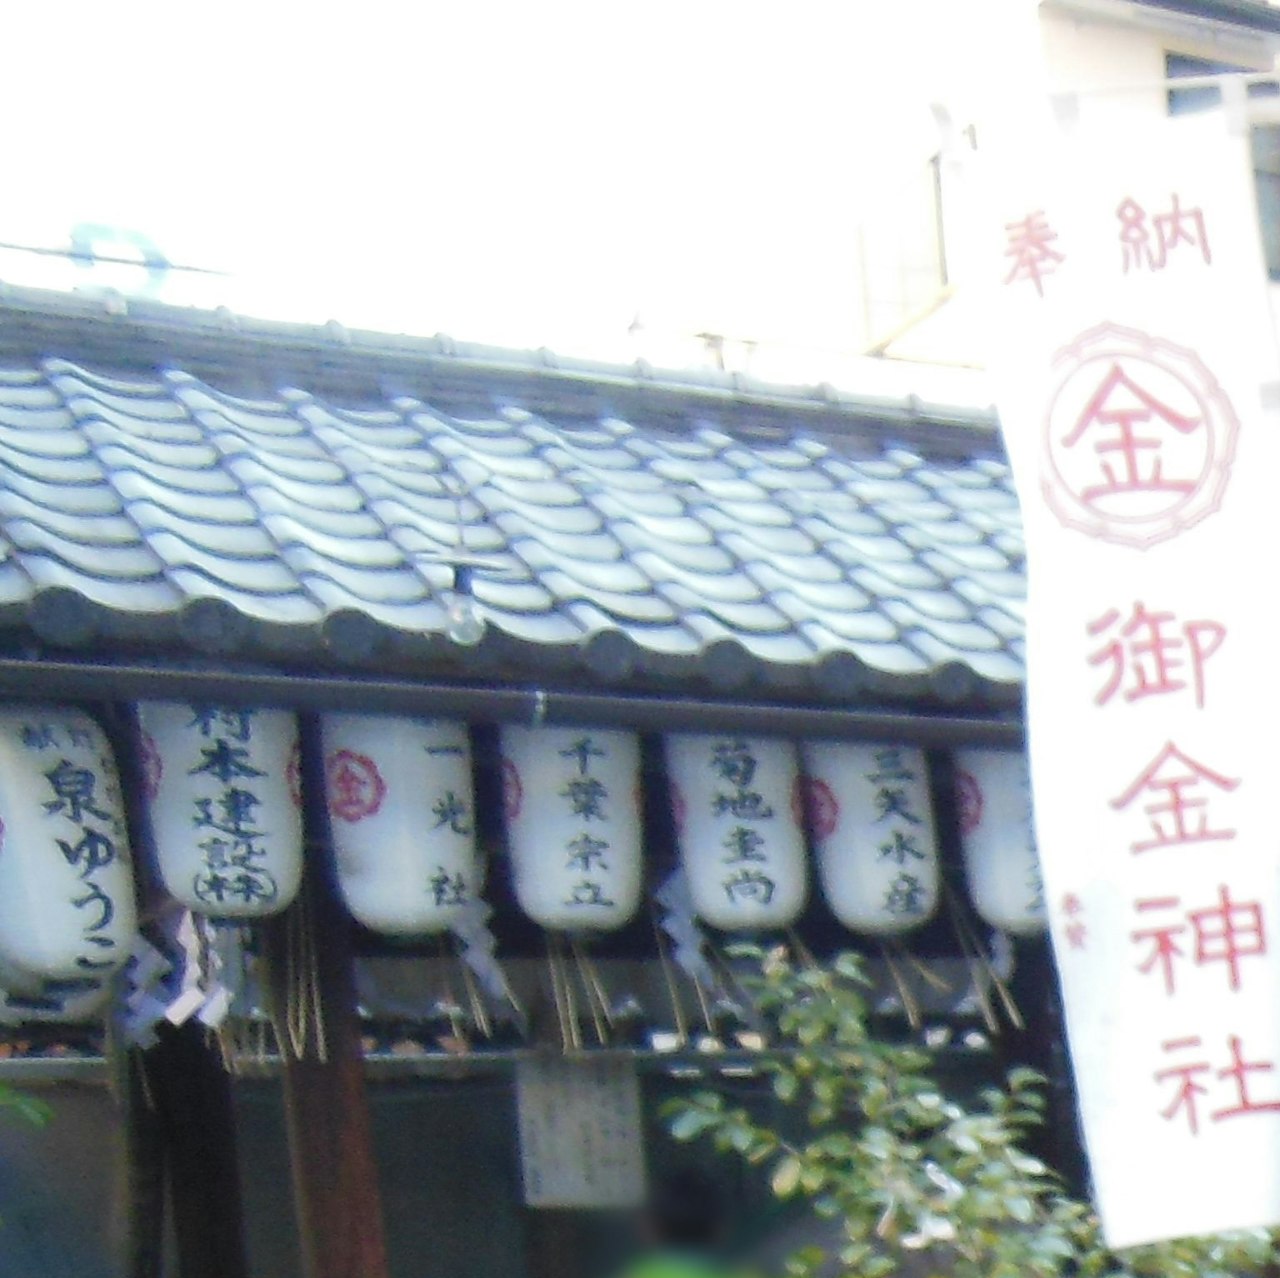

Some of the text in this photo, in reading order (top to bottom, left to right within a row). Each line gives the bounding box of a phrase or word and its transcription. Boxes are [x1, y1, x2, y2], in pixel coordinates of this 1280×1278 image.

[1061, 361, 1203, 502] 金
[41, 758, 116, 969] 泉ゆうこ
